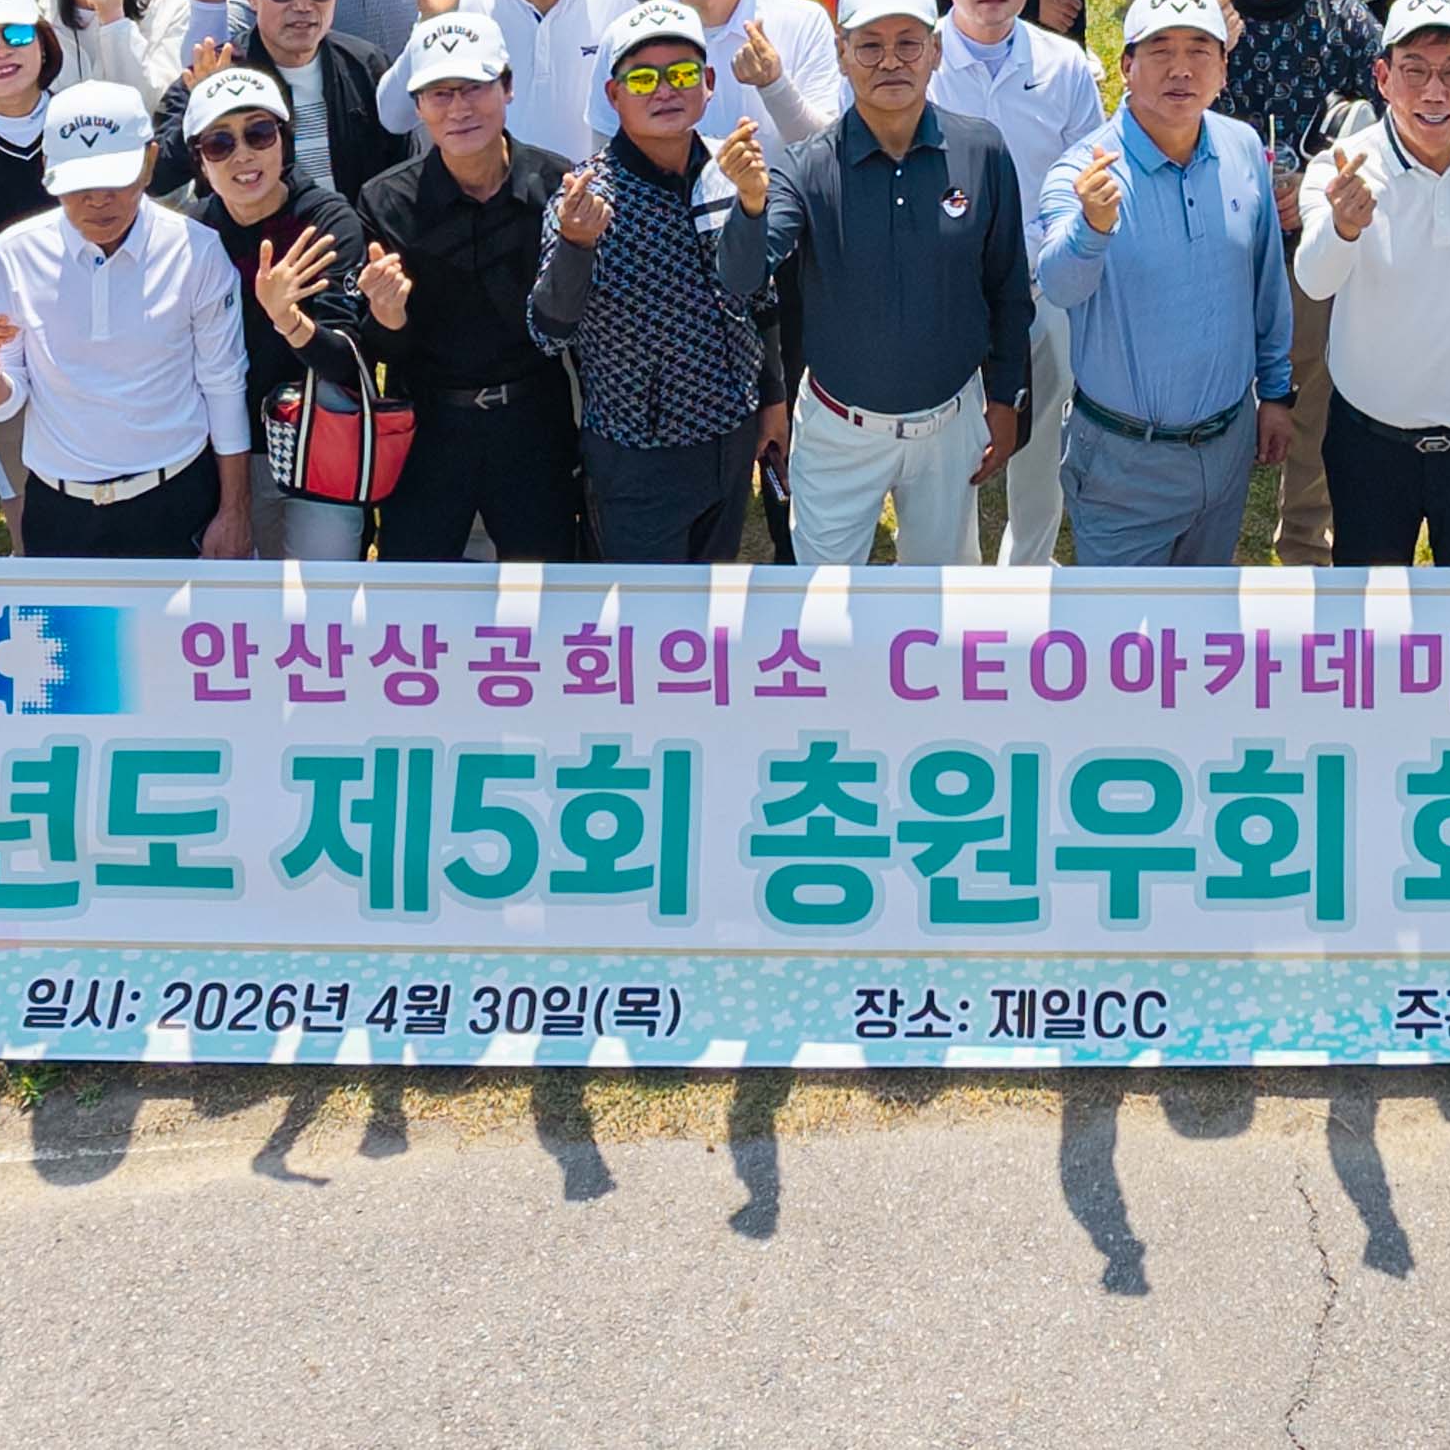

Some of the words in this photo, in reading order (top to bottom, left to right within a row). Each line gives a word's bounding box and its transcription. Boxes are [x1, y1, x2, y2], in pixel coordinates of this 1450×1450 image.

[630, 8, 685, 27] Callaway
[423, 25, 479, 49] Callaway
[207, 75, 263, 97] Callaway
[60, 116, 120, 138] Callaway
[181, 620, 828, 707] 안산상공회의소
[281, 744, 691, 916] 제5회
[750, 741, 1345, 925] 총원우회
[22, 978, 140, 1031] 일시:
[157, 980, 350, 1034] 2026년
[365, 984, 451, 1035] 4월
[468, 984, 682, 1039] 30일(목)
[854, 987, 969, 1040] 장소:
[989, 988, 1168, 1040] 제일CC
